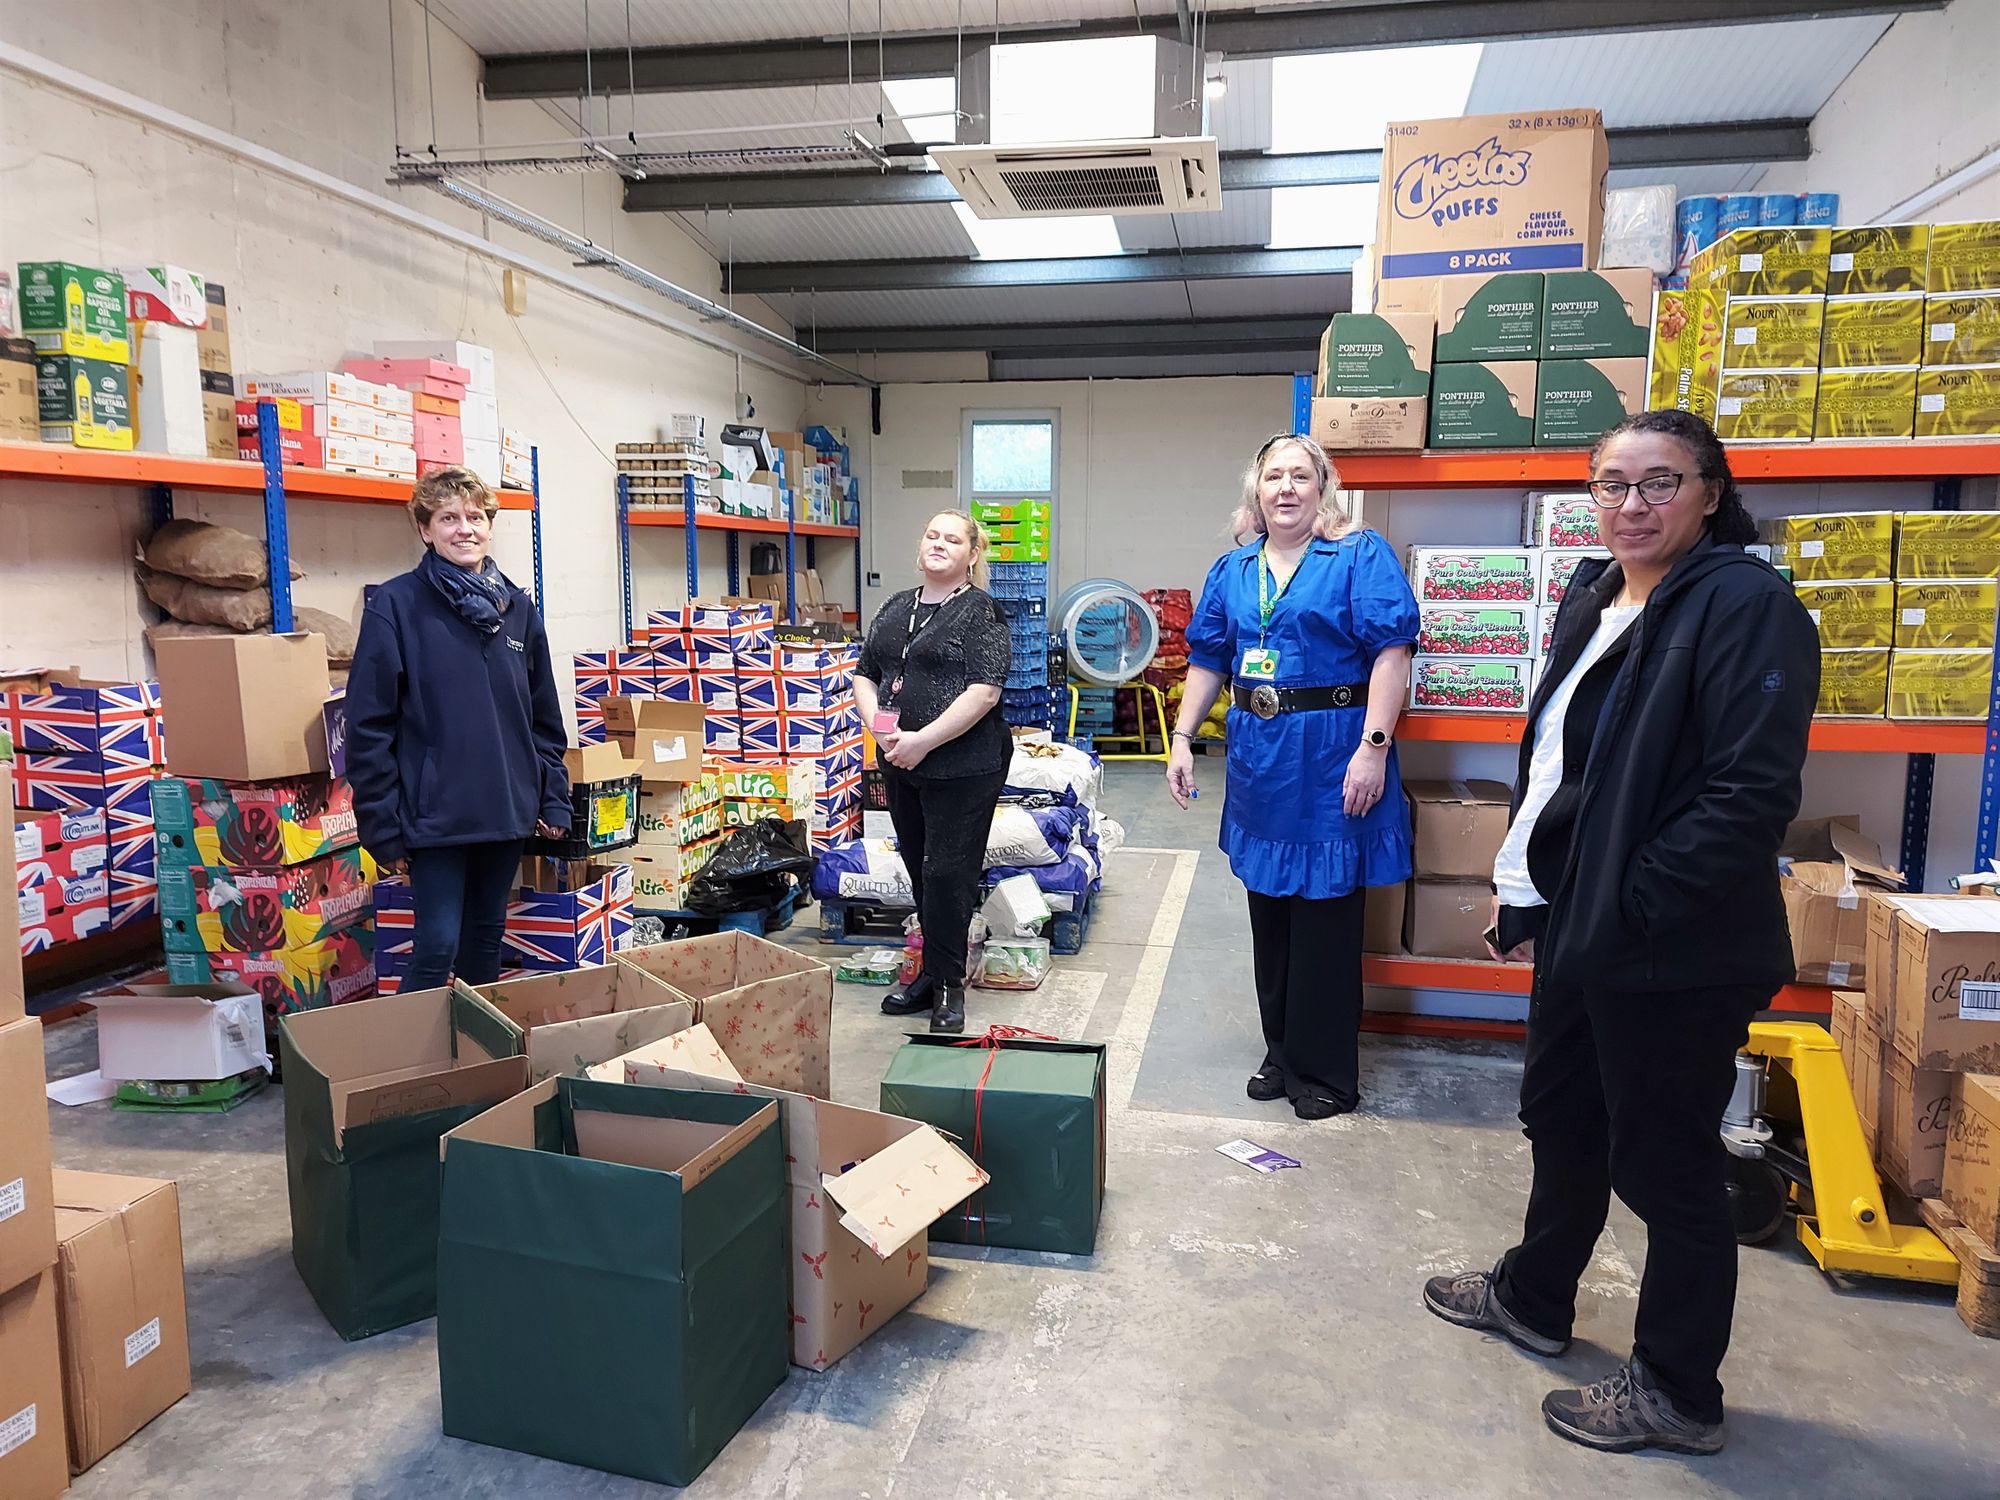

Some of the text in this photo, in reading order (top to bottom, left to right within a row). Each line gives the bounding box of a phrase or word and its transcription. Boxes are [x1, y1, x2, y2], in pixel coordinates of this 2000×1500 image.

[1508, 119, 1522, 129] 32
[1534, 118, 1544, 130] (8
[1387, 126, 1419, 136] 51402
[1394, 135, 1532, 219] Cheetos
[1431, 197, 1499, 227] PUFFS
[1529, 211, 1562, 220] CHEESE
[1525, 220, 1567, 229] FLAVOUR
[1517, 228, 1574, 239] CORN PUFFS
[1449, 252, 1512, 267] 8 PACK
[1487, 302, 1535, 313] PONTHIER
[1551, 301, 1600, 311] PONTHIER
[1948, 303, 1982, 315] NOURI
[1746, 307, 1778, 320] NOURI
[1338, 344, 1384, 352] PONTHIER
[1677, 367, 1693, 395] Palm
[1938, 375, 1971, 386] NOURI
[271, 387, 311, 395] DESECADAS
[1439, 392, 1486, 401] PONTHIER
[1545, 391, 1593, 399] PONTHIER
[1556, 514, 1581, 523] Pure
[1813, 521, 1846, 533] NOURI
[1429, 568, 1531, 578] Pure Cooked Beetroot
[1815, 590, 1847, 601] NOURI
[1917, 589, 1950, 601] NOURI
[1424, 623, 1525, 632] Pure Cooked Beetroot
[784, 633, 811, 642] Choice
[1420, 675, 1521, 685] Pure Cooked Beetroot
[724, 774, 776, 796] olito
[71, 823, 100, 834] FRUITLINK
[74, 886, 103, 896] FRUITLINK
[633, 878, 666, 896] olito
[843, 876, 890, 895] QUALITY
[1949, 1109, 1989, 1142] Belvoir
